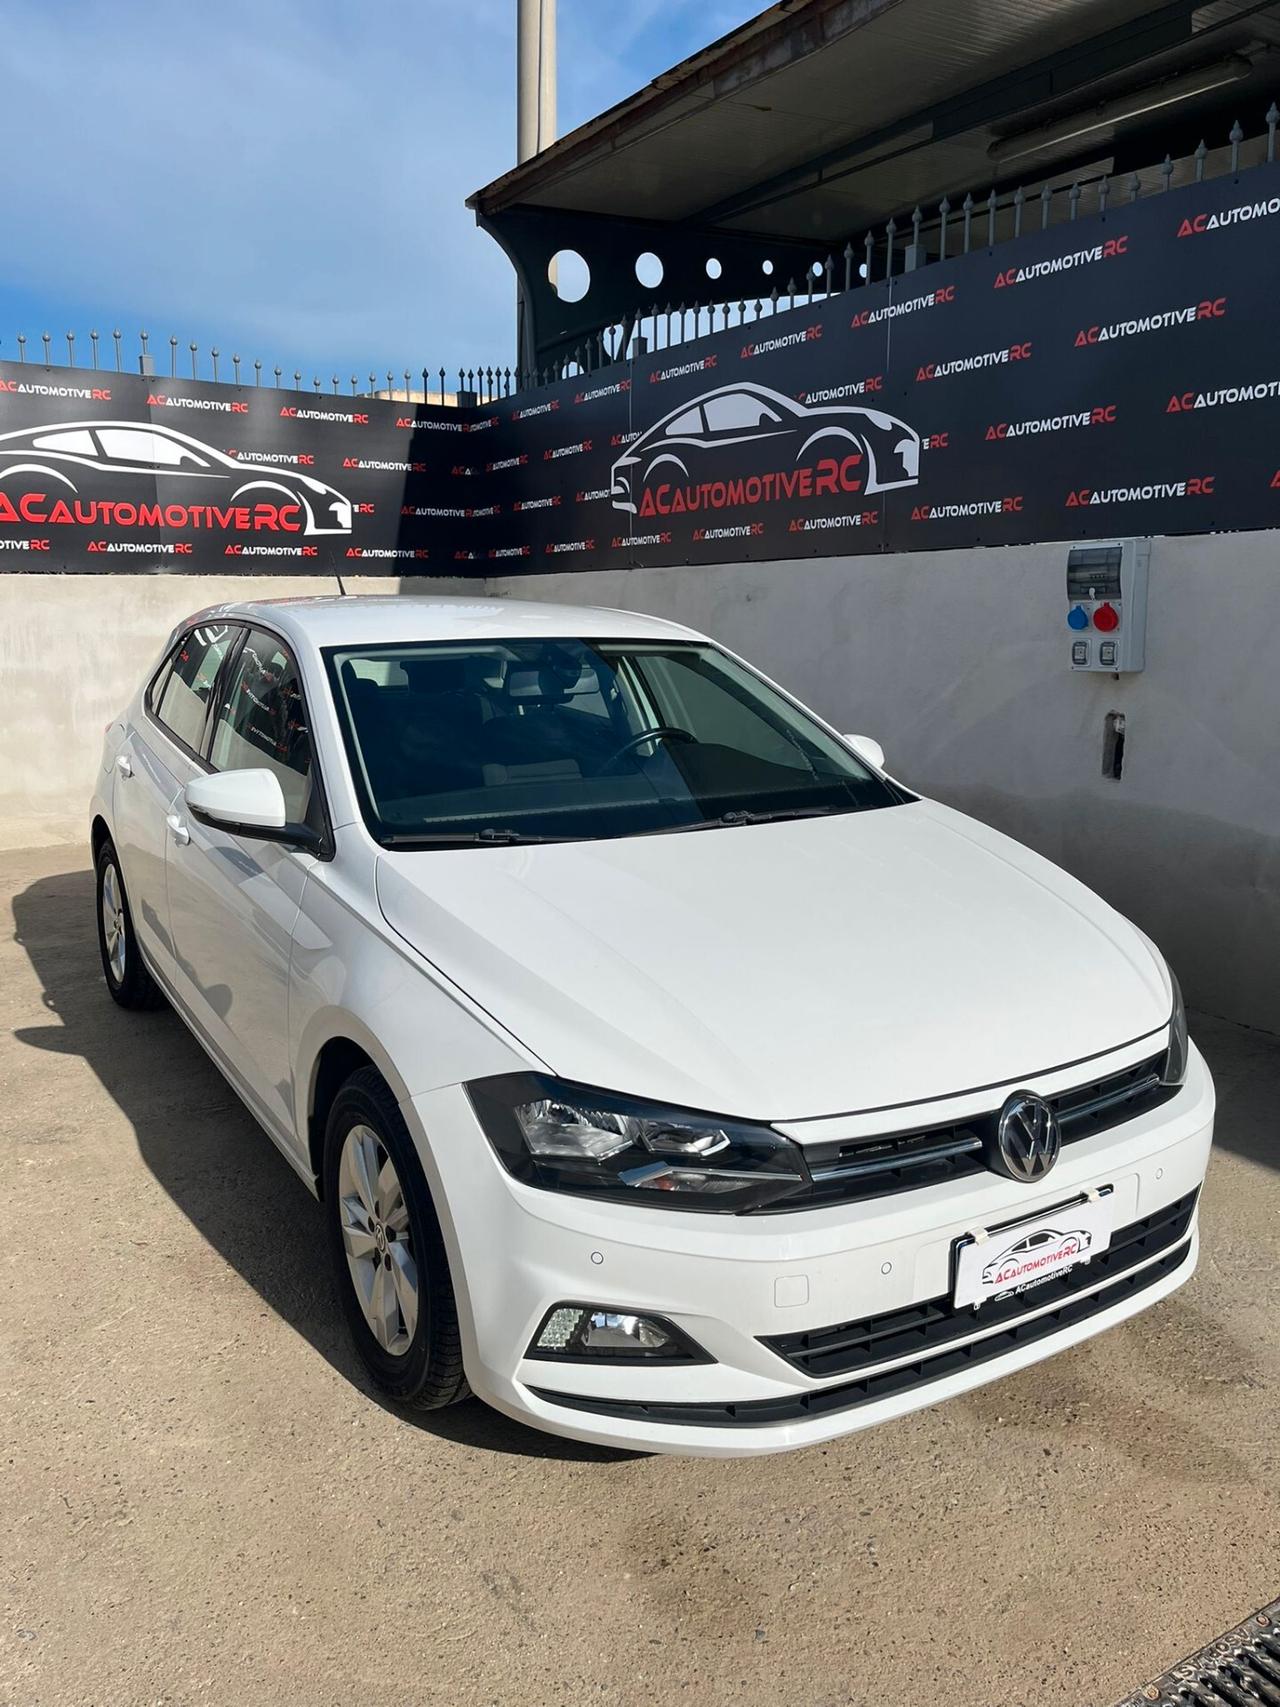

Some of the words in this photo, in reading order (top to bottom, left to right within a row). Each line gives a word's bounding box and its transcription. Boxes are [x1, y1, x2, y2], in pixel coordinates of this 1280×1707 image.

[993, 236, 1128, 289] ACAUTOMOTIVERC
[851, 286, 955, 328] ACAUTOMOTIVERC
[1074, 298, 1226, 347] ACAUTOMOTIVERC
[740, 325, 823, 358] ACAUTOMOTIVERC
[650, 355, 718, 383] ACAUTOMOTIVERC
[916, 342, 1032, 381] ACAUTOMOTIVERC
[0, 380, 111, 400] ACAUTOMOTIVERC
[574, 379, 631, 404] ACAUTOMOTIVERC
[795, 376, 883, 404] AUTOMOTIVERC
[147, 394, 248, 413] ACAUTOMOTIVERC
[512, 400, 560, 421] ACAUTOMOTIVERC
[280, 407, 369, 424] ACAUTOMOTIVERC
[985, 405, 1116, 441] ACAUTOMOTIVERC
[224, 448, 314, 465] AUTOMOTIVERC
[544, 440, 593, 461] ACAUTOMOTIVERC
[343, 457, 426, 472] ACAUTOMOTIVERC
[639, 454, 863, 517] ACAUTOMOTIVERC
[1065, 476, 1215, 507] ACAUTOMOTIVERC
[0, 491, 301, 531] ACAUTOMOTIVERC
[513, 495, 561, 511] ACAUTOMOTIVERC
[911, 496, 1024, 521] ACAUTOMOTIVERC
[692, 523, 764, 542] ACAUTOMOTIVERC
[789, 511, 878, 532] ACAUTOMOTIVERC
[87, 541, 193, 554] ACAUTOMOTIVERC
[225, 544, 318, 557] ACAUTOMOTIVERC
[545, 539, 596, 554] ACAUTOMOTIVERC
[612, 531, 672, 548] ACAUTOMOTIVERC
[346, 547, 429, 559] ACAUTOMOTIVERC
[994, 1243, 1077, 1284] ACAUTOMOTIVERC
[1015, 1264, 1074, 1295] ACautomotiveRC
